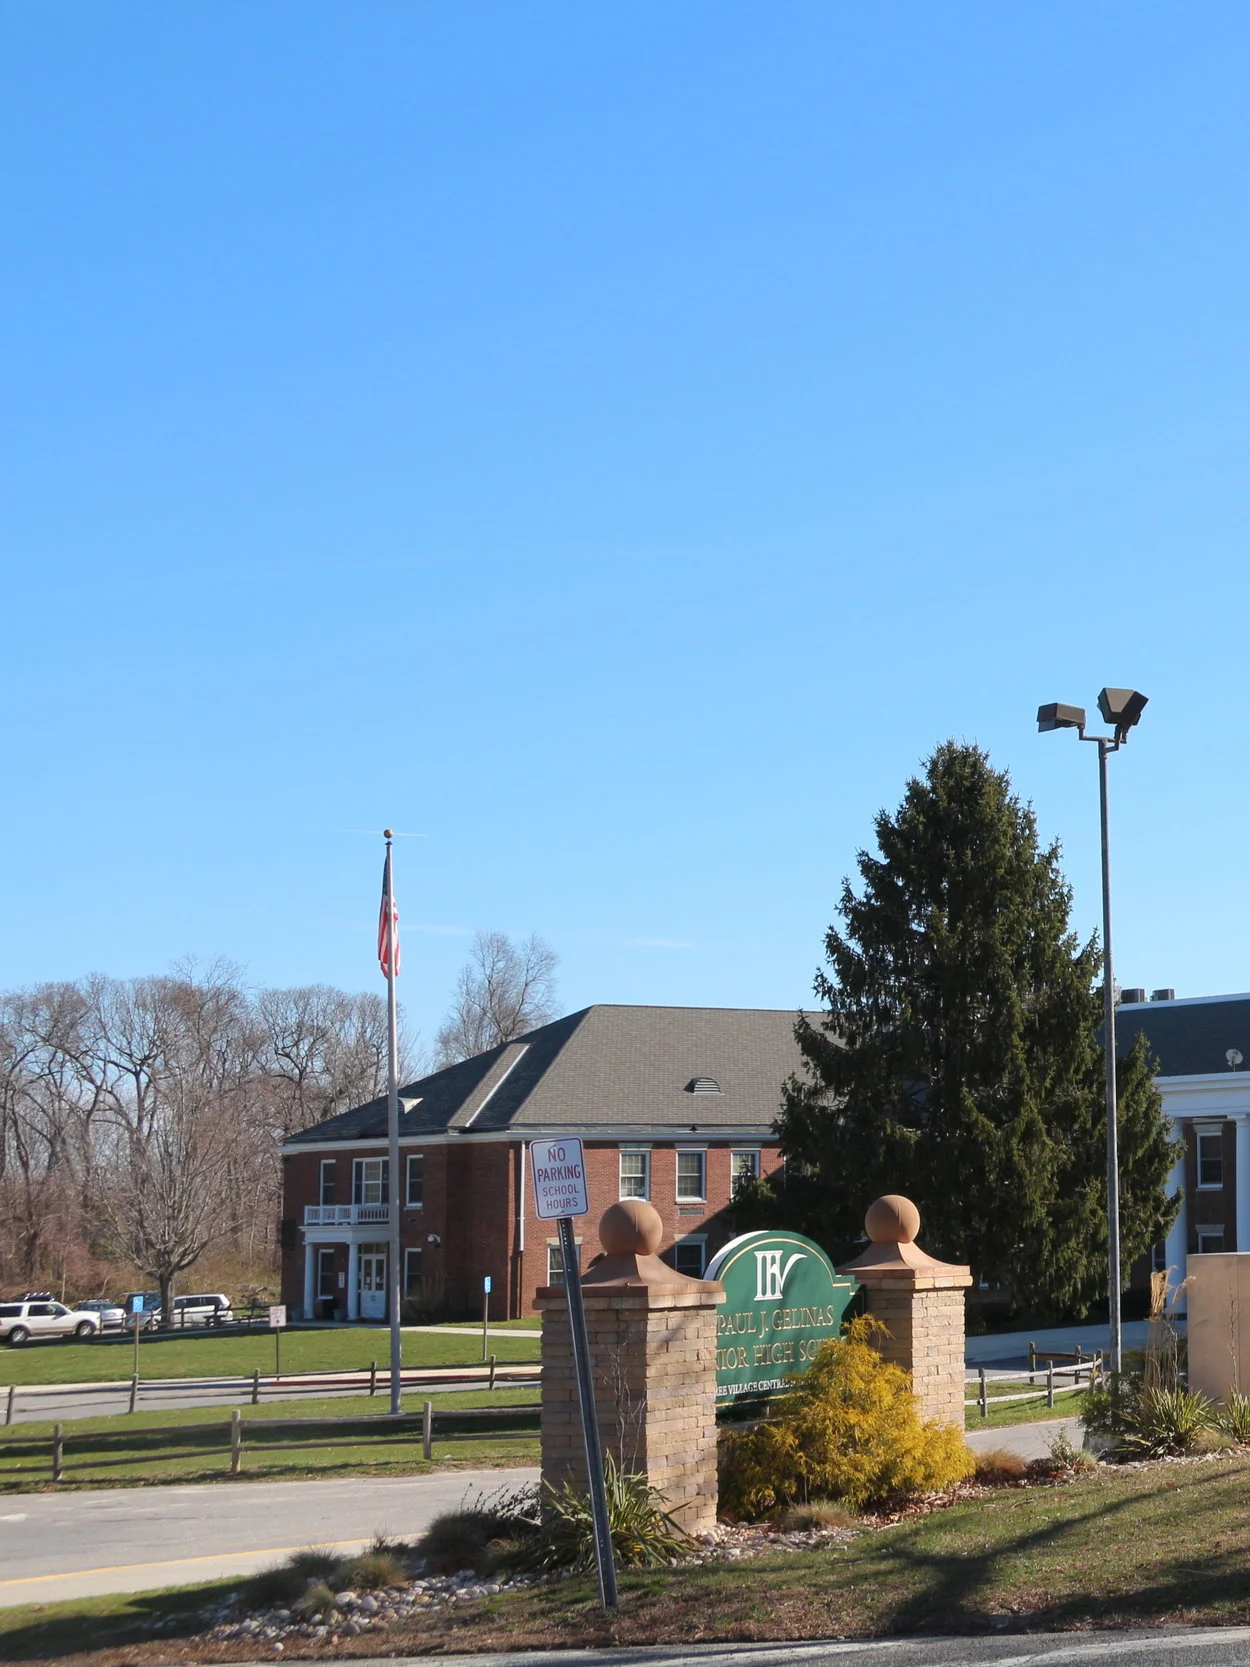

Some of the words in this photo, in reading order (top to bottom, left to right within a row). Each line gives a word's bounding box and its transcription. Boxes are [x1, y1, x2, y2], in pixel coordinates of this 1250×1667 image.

[547, 1147, 566, 1163] NO
[537, 1164, 581, 1183] PARKING
[542, 1184, 580, 1197] SCHOOL
[546, 1197, 578, 1210] HOURS
[716, 1312, 757, 1336] PAUL
[758, 1311, 769, 1339] J.
[771, 1304, 834, 1331] GELINAS
[753, 1341, 795, 1366] HIGH
[728, 1381, 758, 1395] VILLAGE
